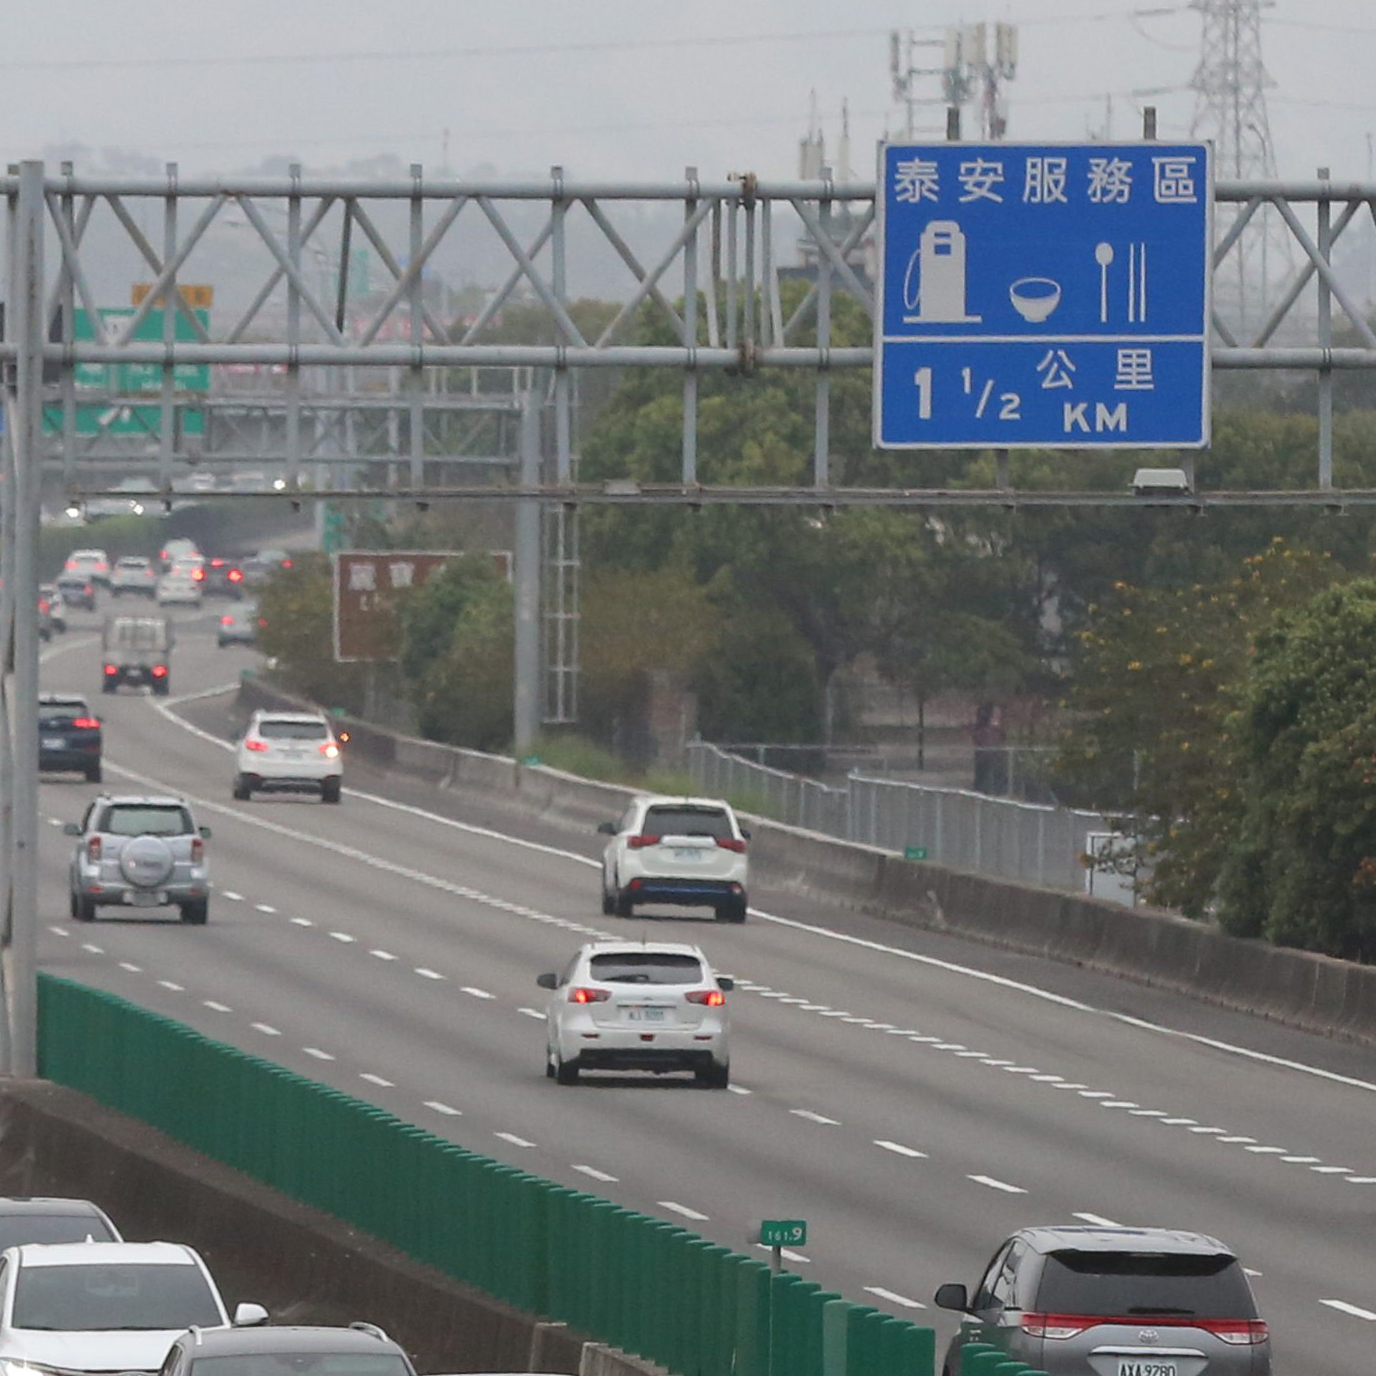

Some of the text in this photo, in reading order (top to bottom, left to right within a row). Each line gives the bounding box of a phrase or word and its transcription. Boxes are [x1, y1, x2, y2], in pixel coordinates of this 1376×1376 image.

[894, 157, 1198, 203] 泰安服務區
[1036, 349, 1155, 390] 公里
[1062, 401, 1128, 432] KM
